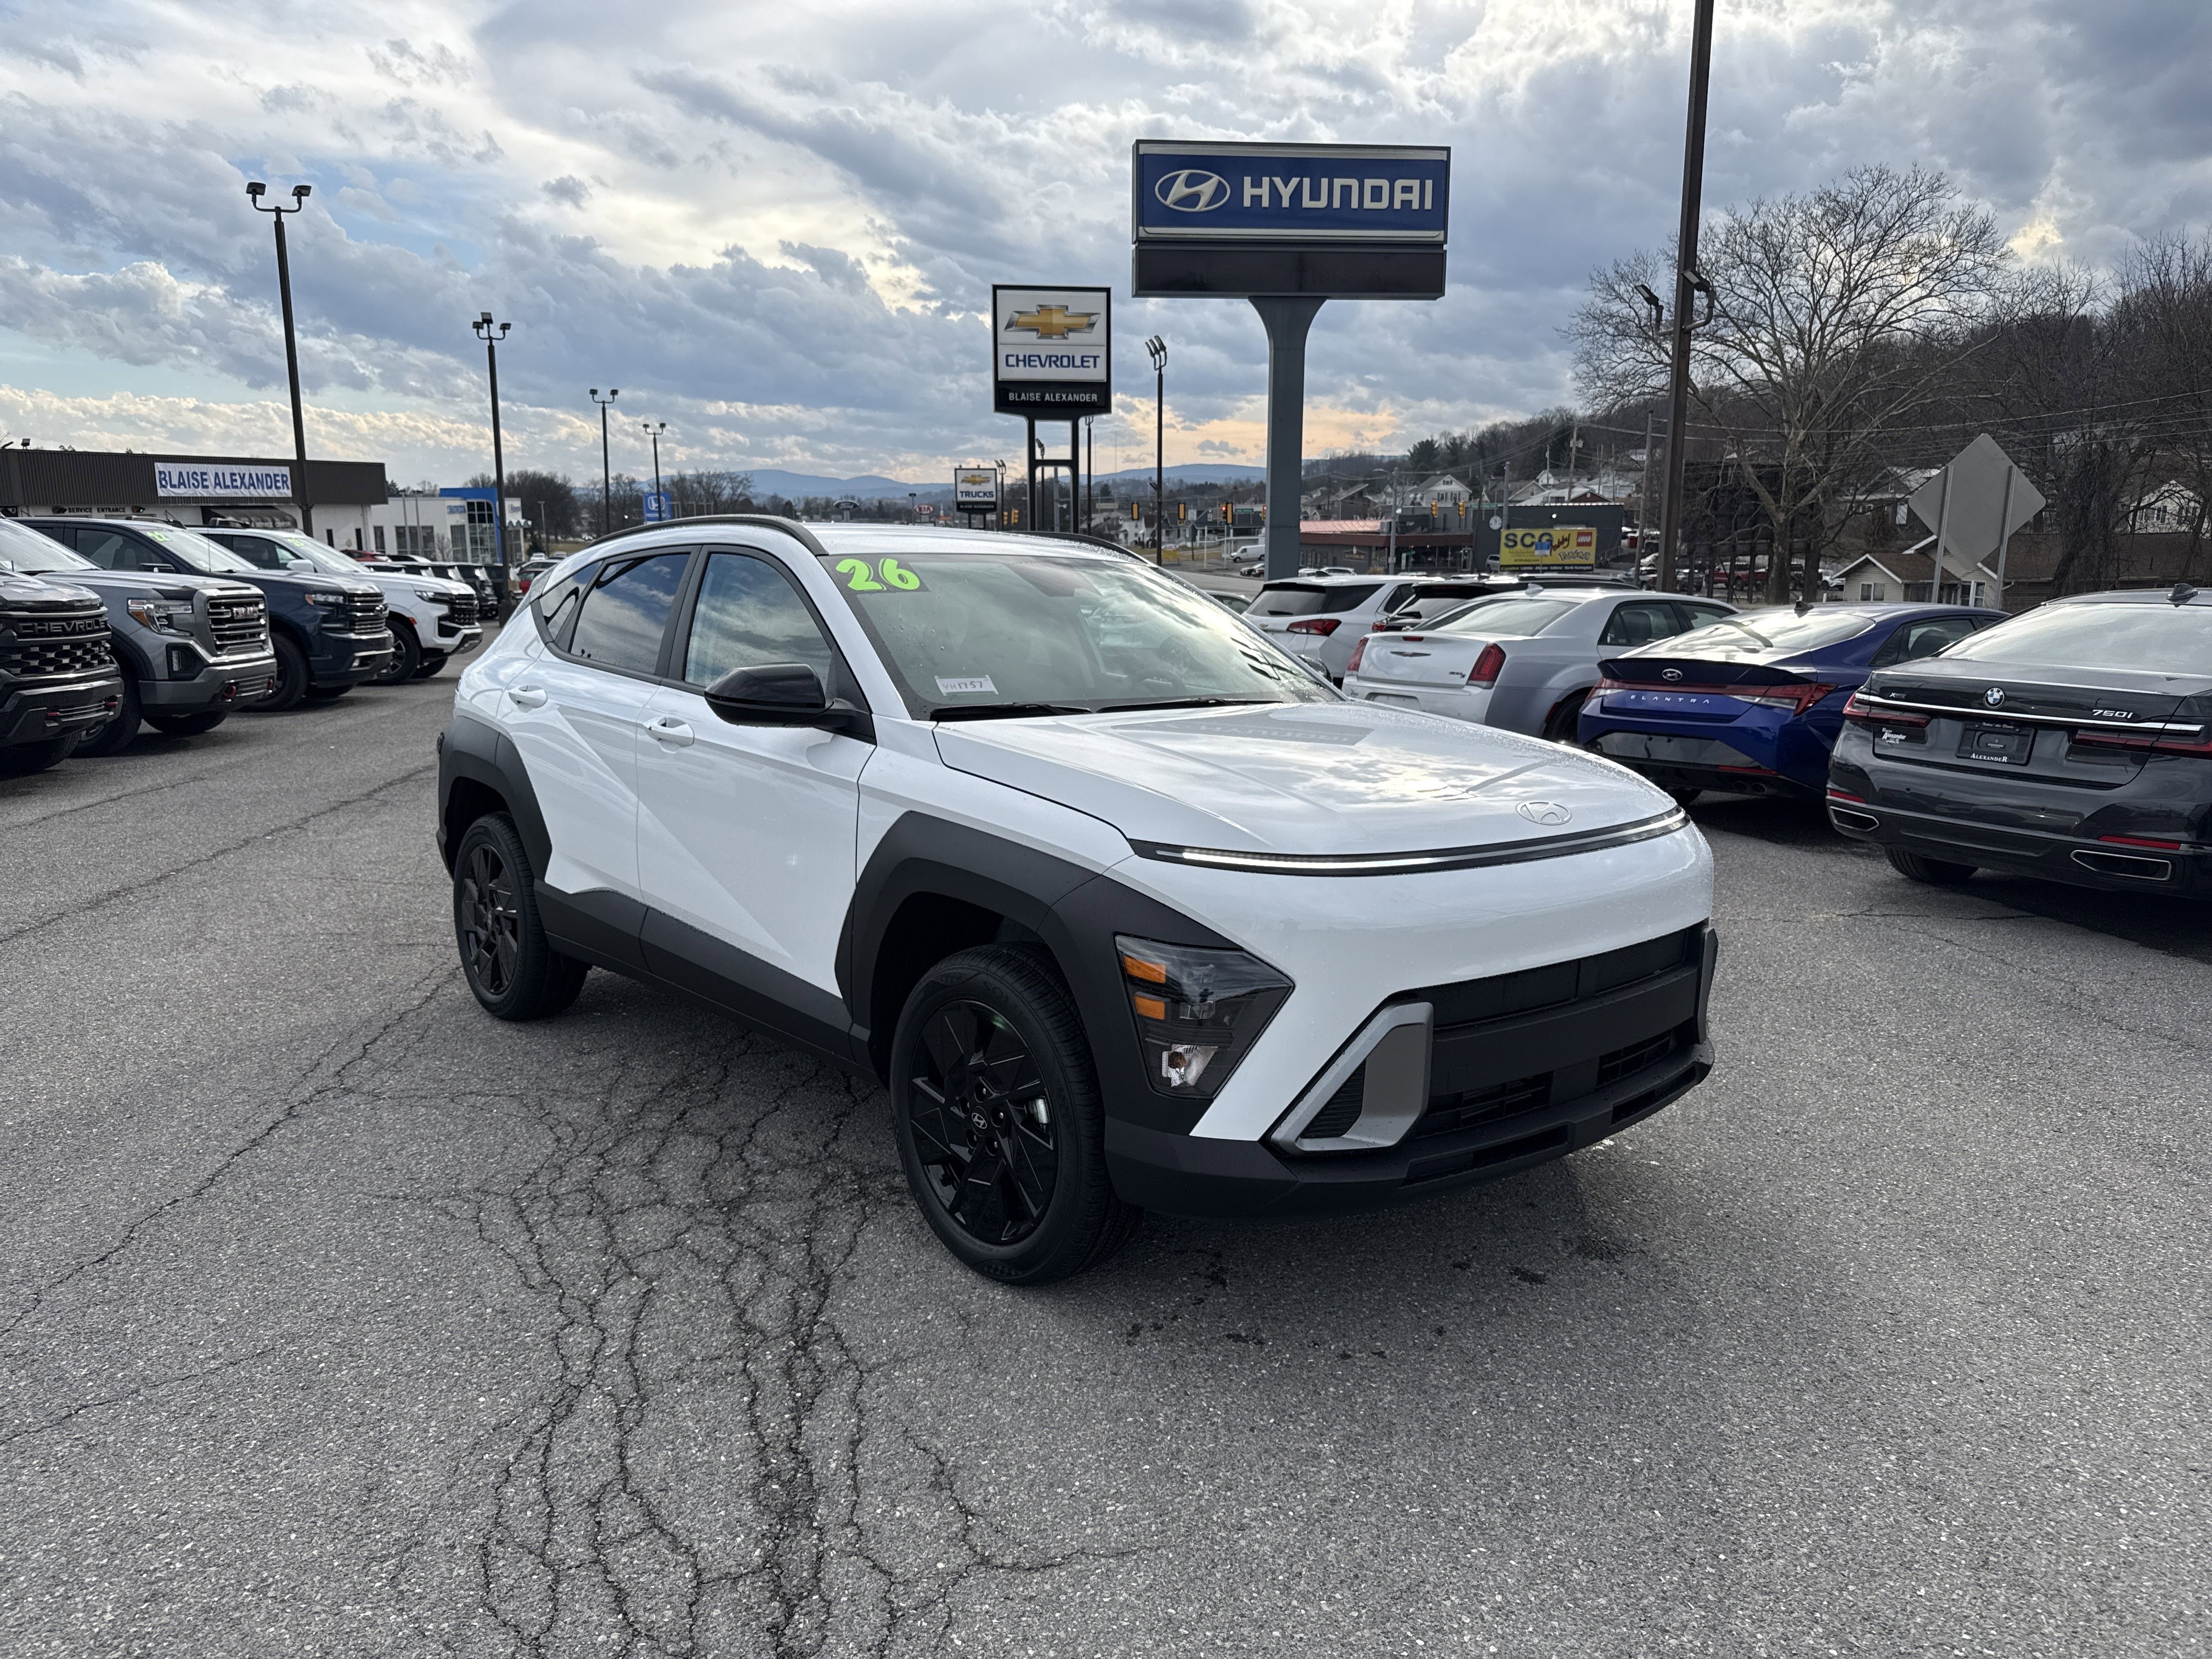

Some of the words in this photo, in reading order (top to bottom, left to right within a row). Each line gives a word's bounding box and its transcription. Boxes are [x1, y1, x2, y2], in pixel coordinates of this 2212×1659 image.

[1243, 176, 1432, 210] HYUNDAI
[1005, 354, 1100, 369] CHEVROLET
[1008, 392, 1041, 402] BLAISE
[1044, 393, 1098, 402] ALEXANDER
[158, 470, 210, 489] BLAISE
[213, 472, 290, 490] ALEXANDER
[1504, 533, 1554, 548] SCG
[836, 558, 920, 591] 26
[19, 618, 109, 633] CHEVROLE
[1630, 695, 1709, 704] ELANTRA
[1971, 753, 2008, 763] ALEXANDER
